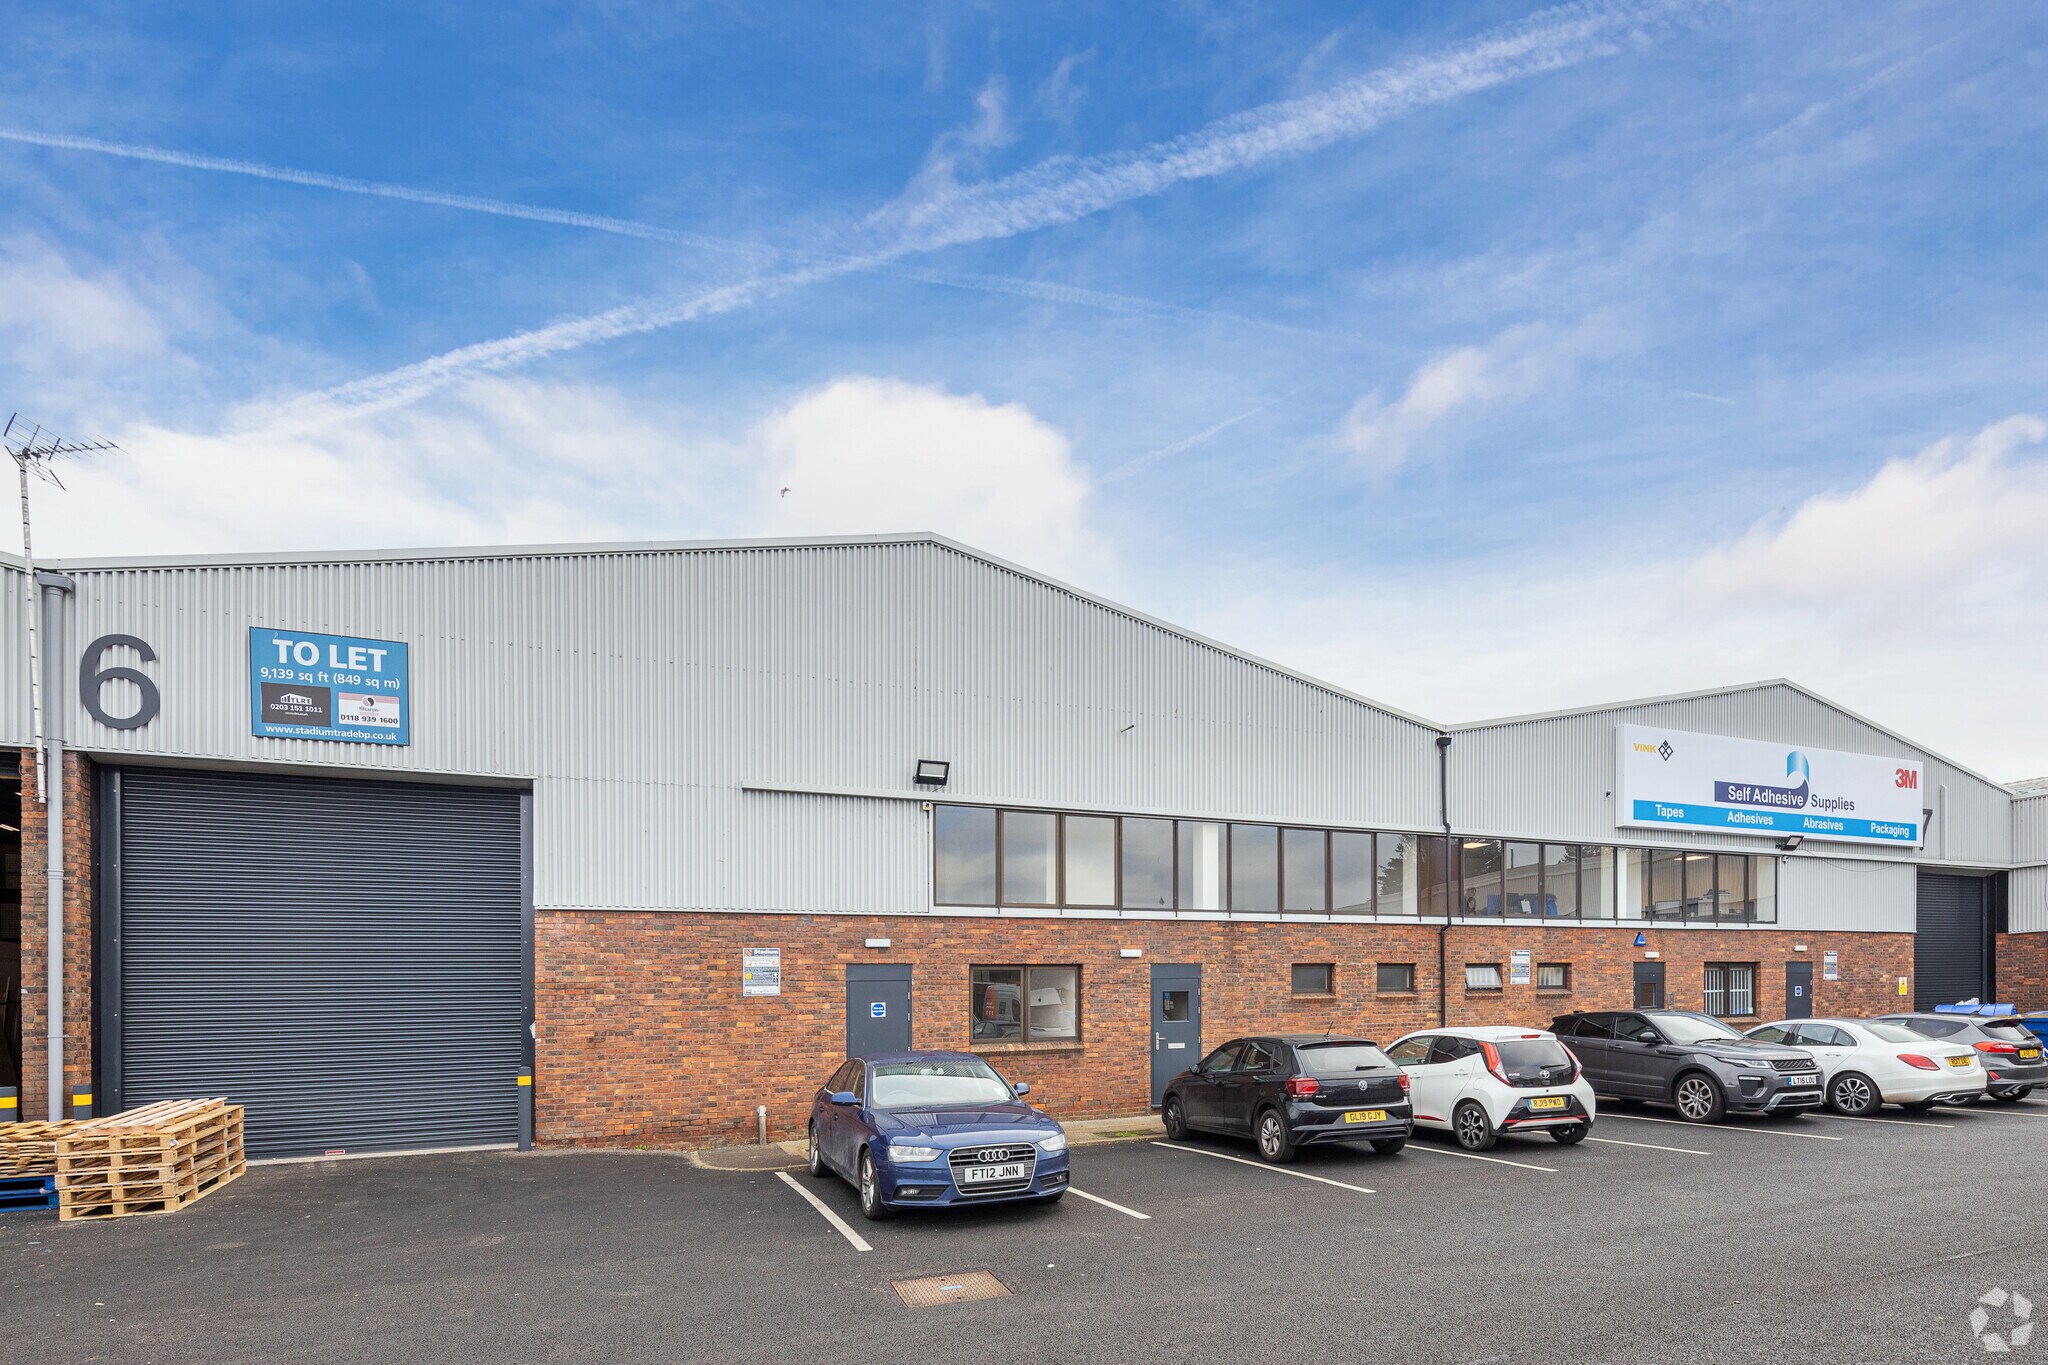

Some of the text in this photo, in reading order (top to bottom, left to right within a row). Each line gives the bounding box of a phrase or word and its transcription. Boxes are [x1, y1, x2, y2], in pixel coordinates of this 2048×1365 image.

[272, 638, 388, 673] TO LET
[79, 634, 160, 730] 6
[260, 667, 400, 690] 9,139 sq ft (849 sq m)
[270, 703, 289, 711] 0203
[361, 715, 377, 723] 939
[265, 725, 397, 741] www.stadiumtradebp.co.uk
[1633, 743, 1657, 754] VINK
[1894, 768, 1918, 789] 3M
[1728, 785, 1855, 813] Self Adhesive Supplies
[1655, 804, 1684, 819] Tapes
[1727, 811, 1774, 826] Adhesives
[1803, 817, 1844, 831] Abrasives
[1870, 822, 1910, 839] Packaging
[1792, 1077, 1805, 1085] LT15
[1533, 1099, 1548, 1107] RJ19
[1349, 1112, 1381, 1121] GL19 GJY
[971, 1165, 1019, 1180] FT12 JNN
